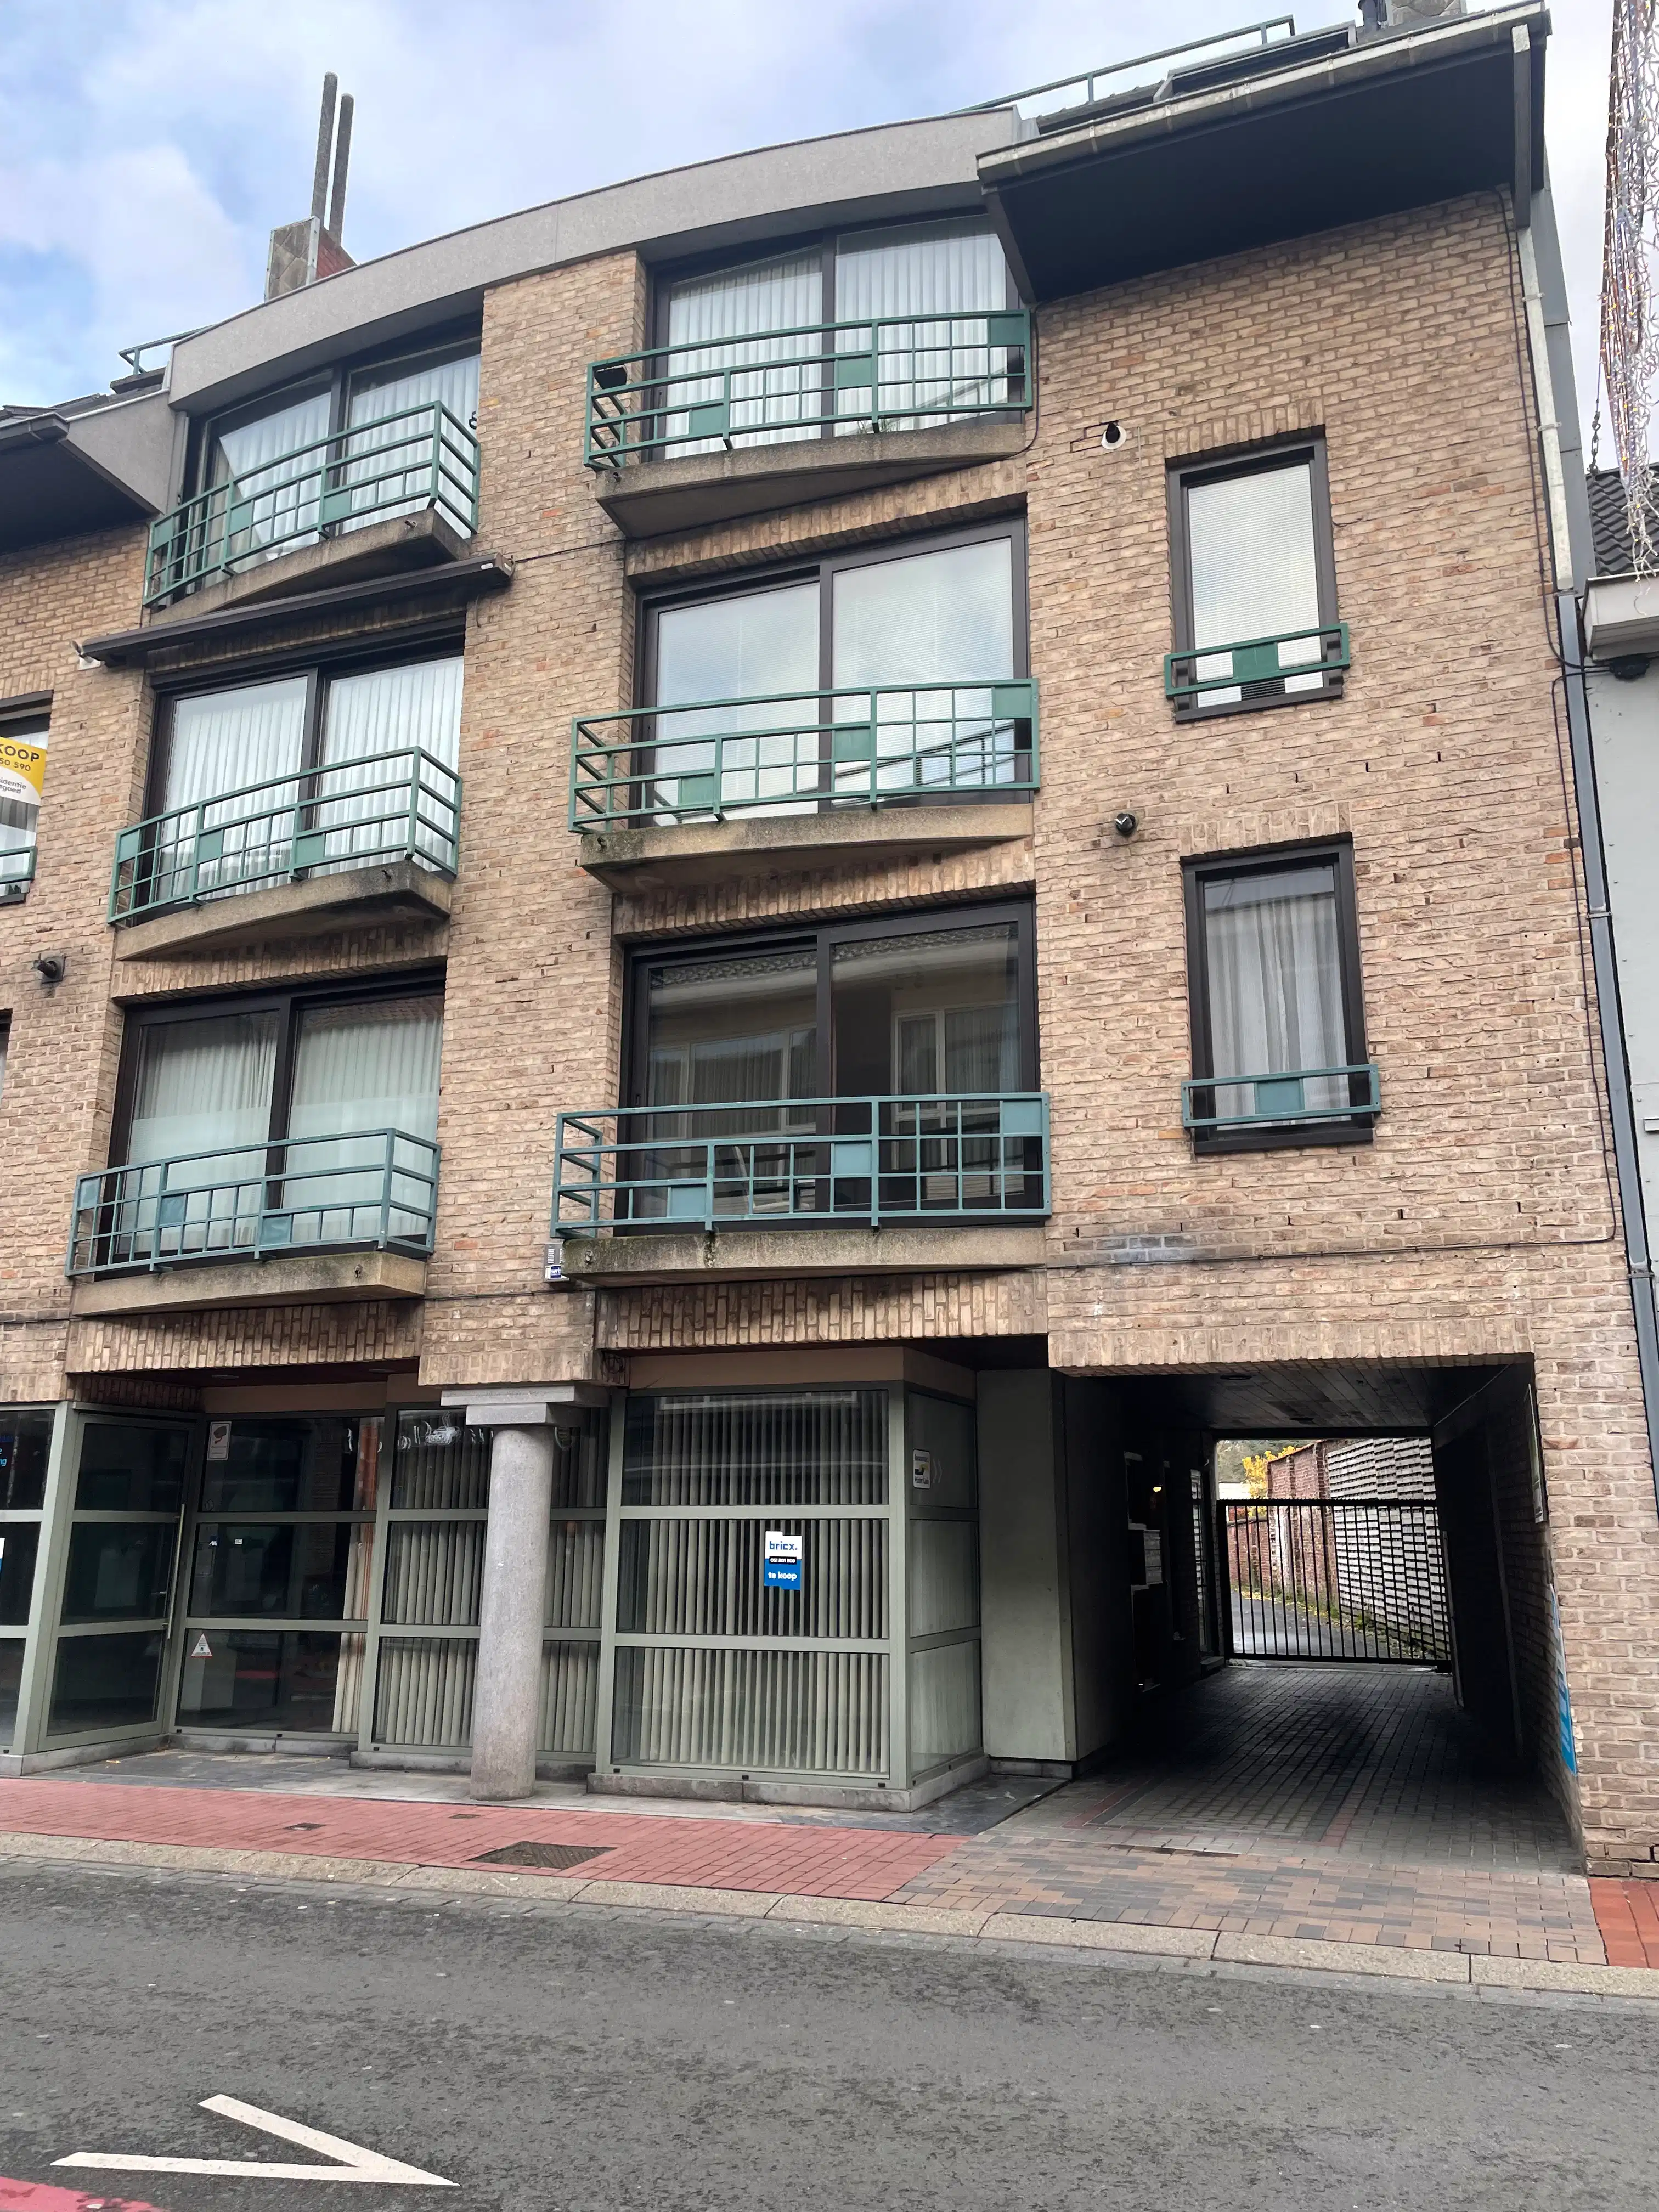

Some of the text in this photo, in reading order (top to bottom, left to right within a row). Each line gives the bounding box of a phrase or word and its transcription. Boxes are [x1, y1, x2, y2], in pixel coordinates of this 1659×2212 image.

[14, 761, 31, 771] 590
[0, 778, 26, 789] identie
[769, 1541, 798, 1550] bricx.
[778, 1571, 797, 1581] koop
